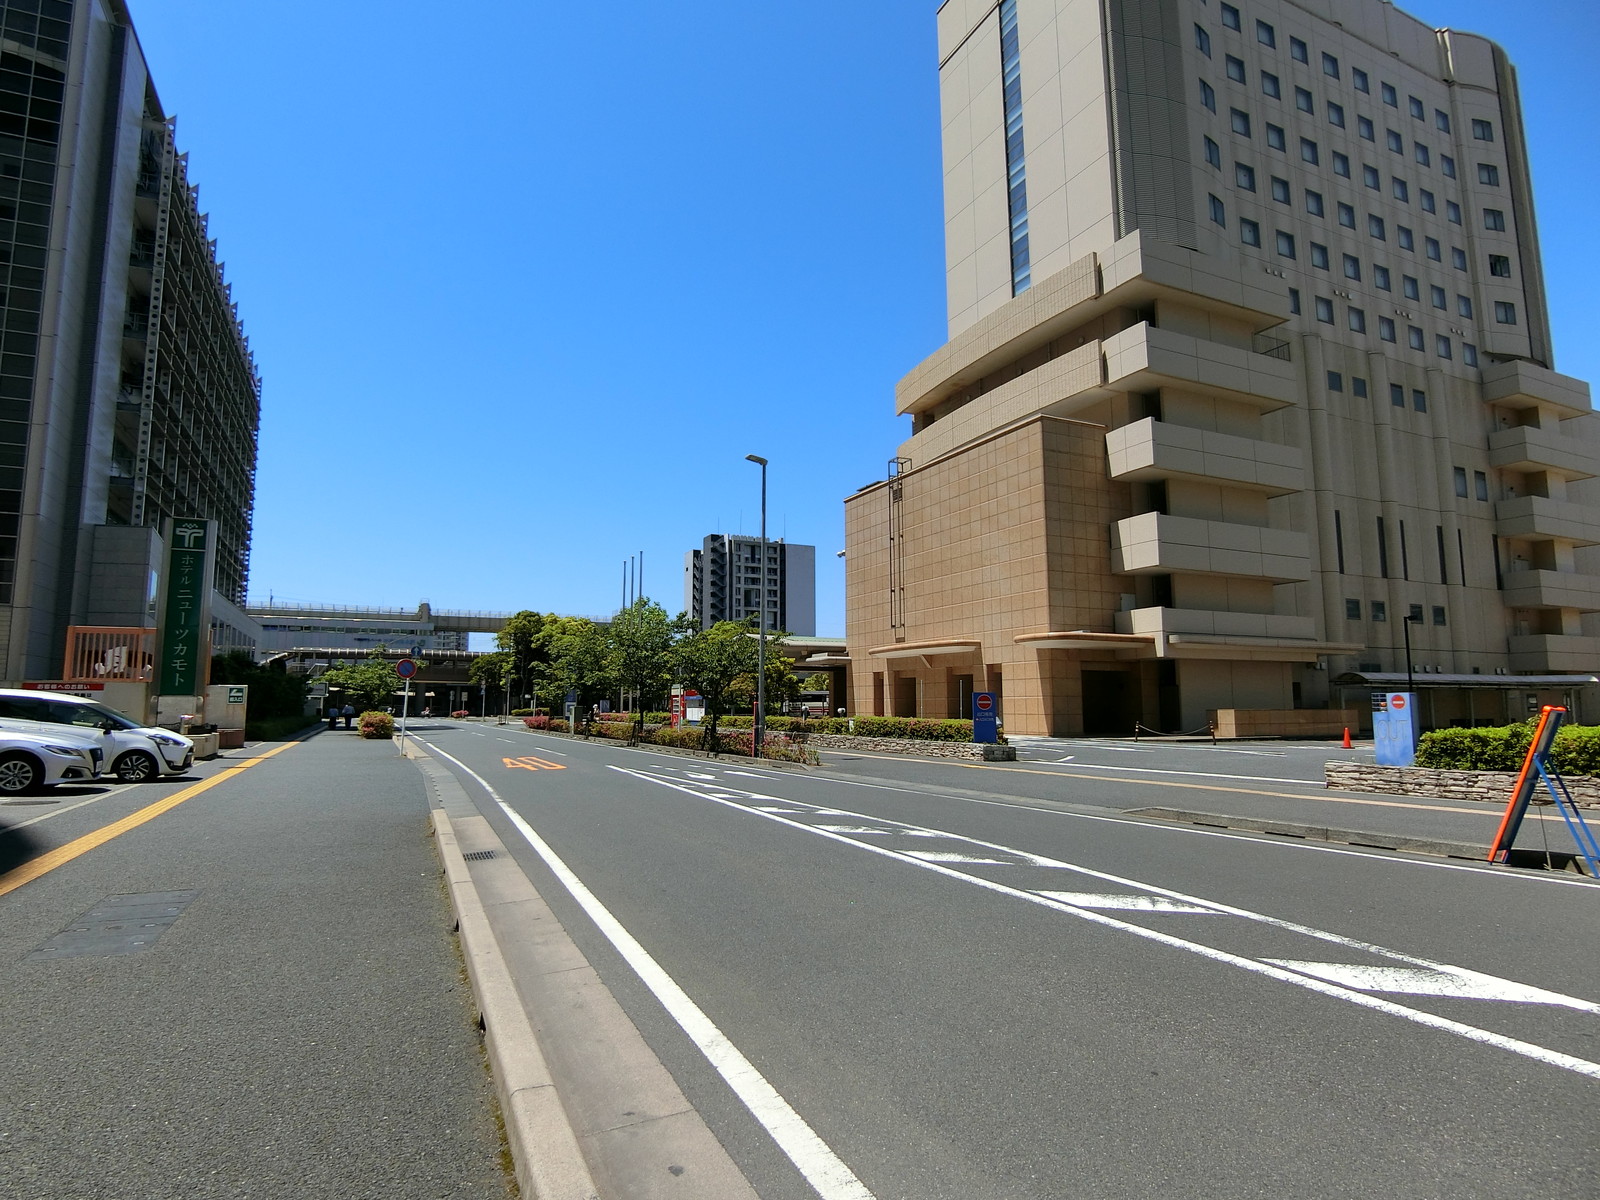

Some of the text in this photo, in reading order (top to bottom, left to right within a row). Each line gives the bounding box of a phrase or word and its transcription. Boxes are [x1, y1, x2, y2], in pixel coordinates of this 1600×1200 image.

[171, 555, 195, 687] ホテルニューツカモト
[1377, 719, 1408, 741] OUT
[502, 756, 568, 771] 40
